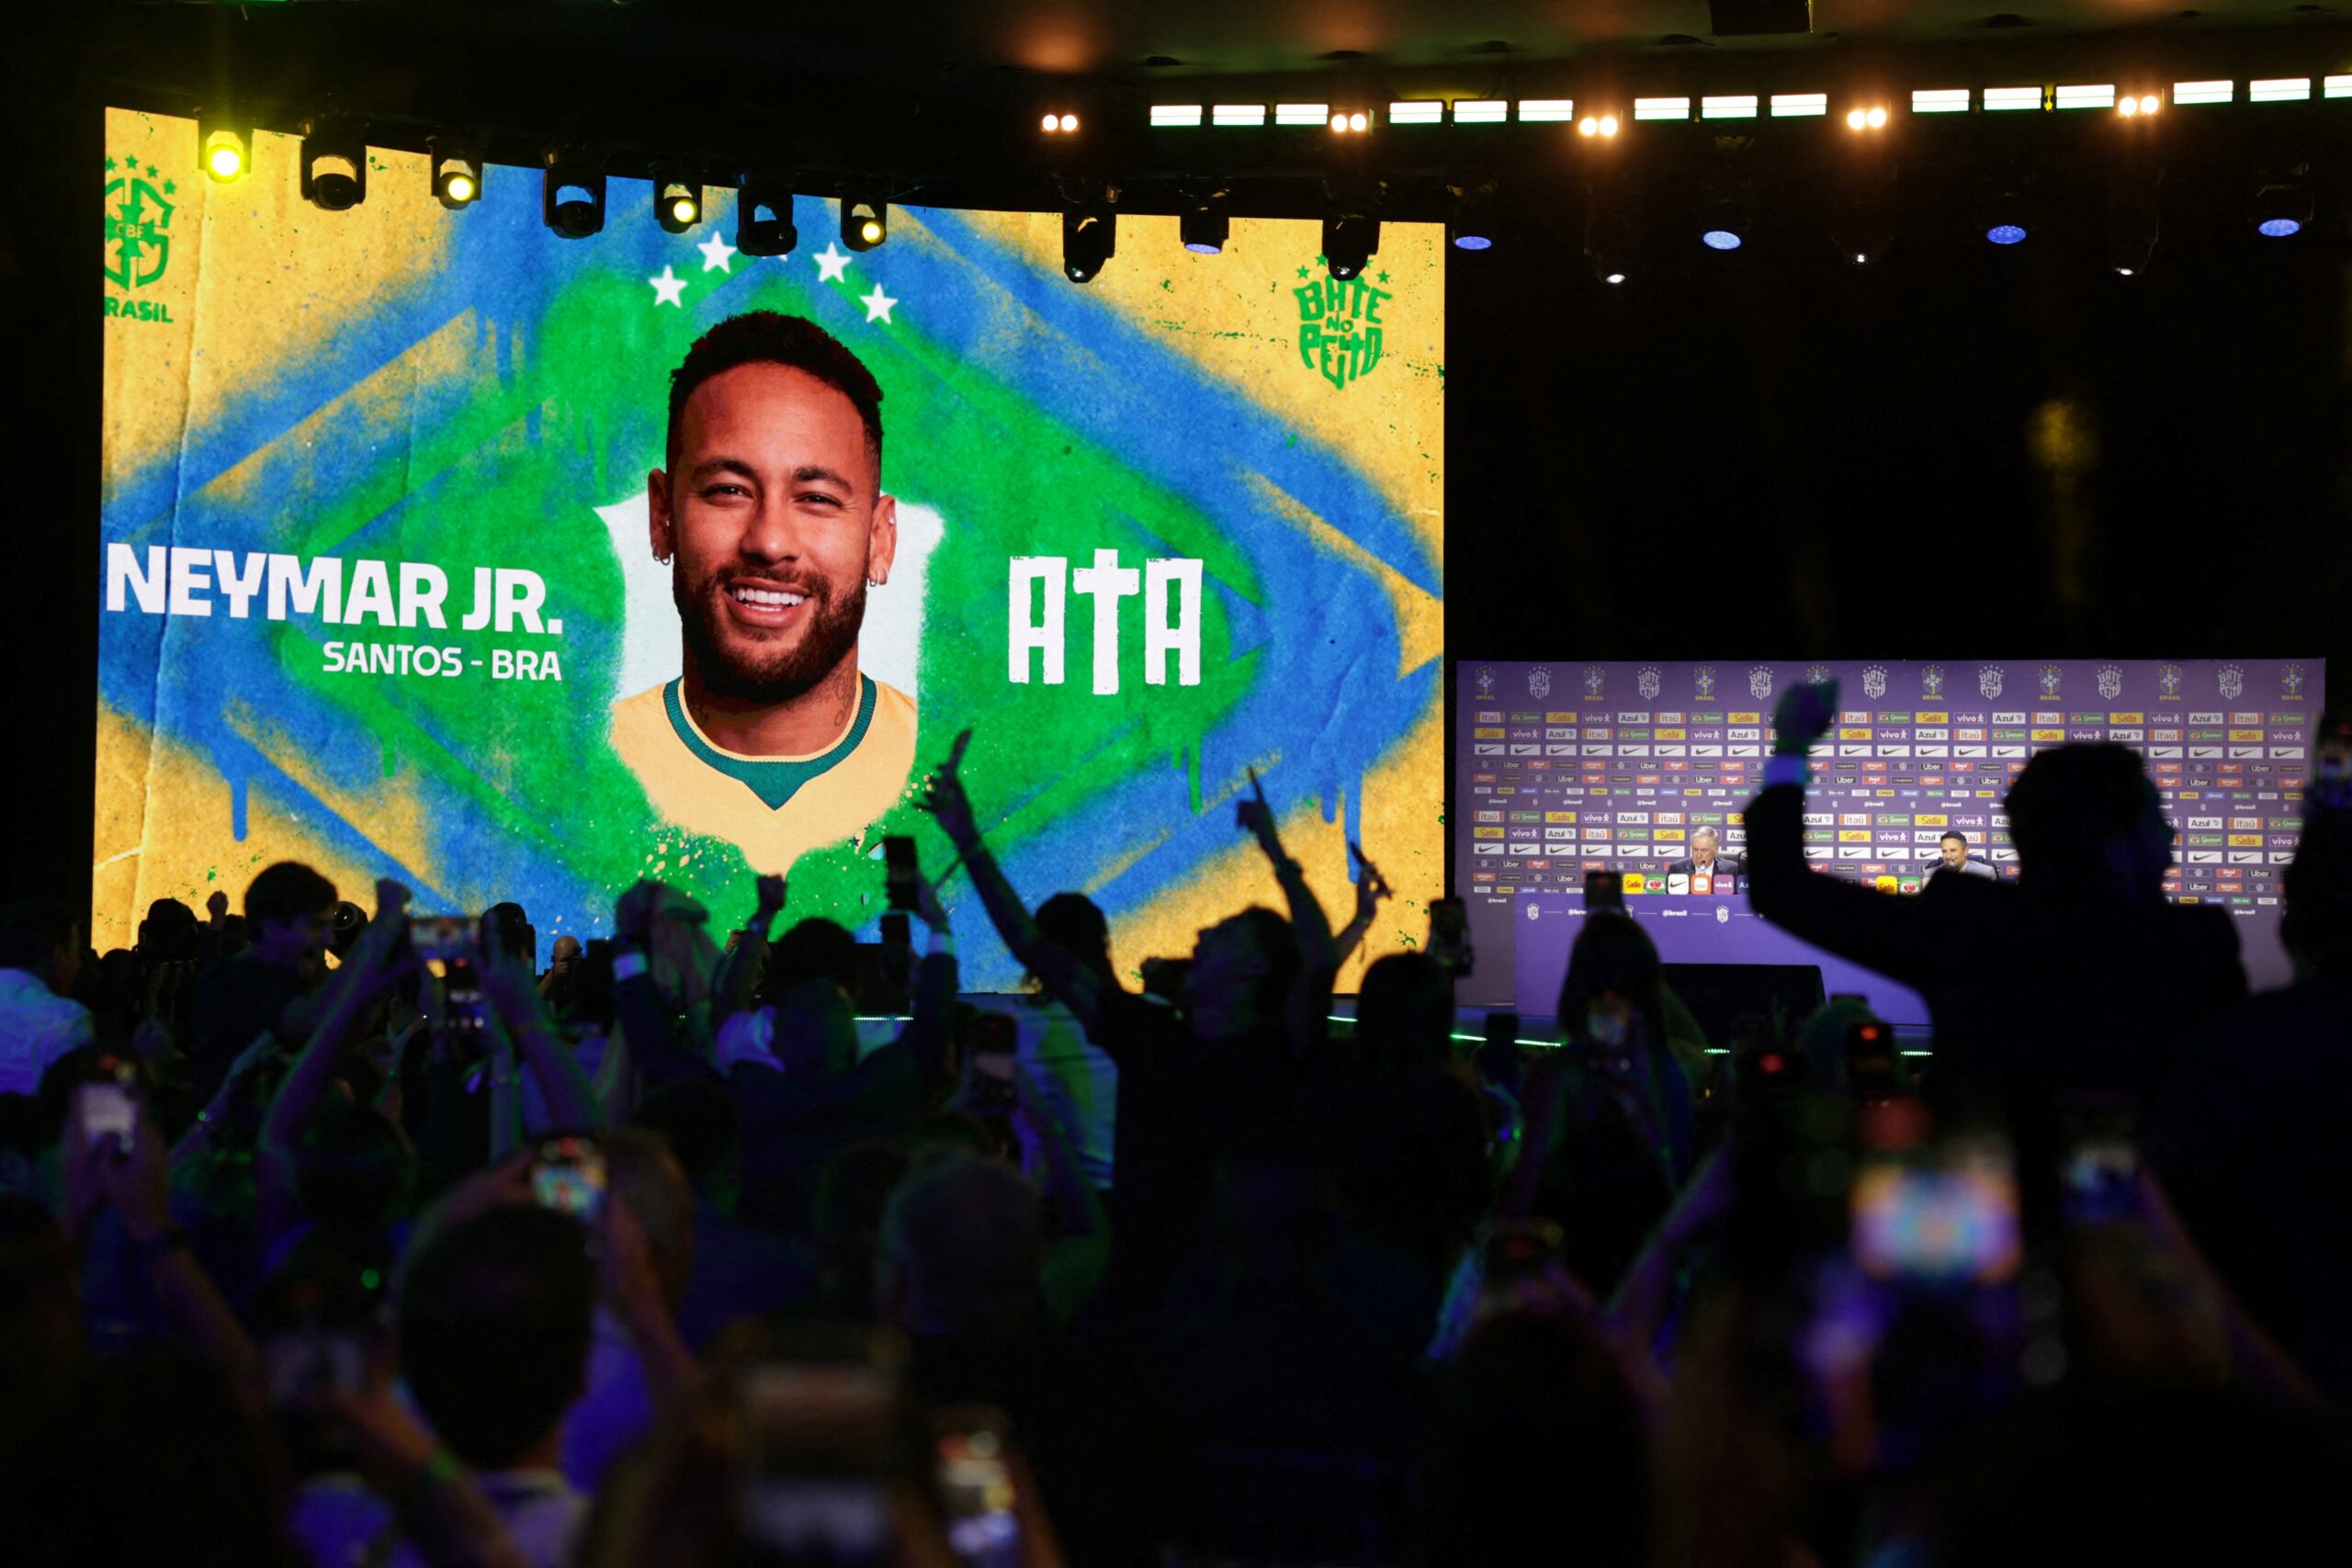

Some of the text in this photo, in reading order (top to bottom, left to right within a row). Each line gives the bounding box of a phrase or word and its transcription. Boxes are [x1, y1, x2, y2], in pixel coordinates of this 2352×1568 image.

[104, 297, 175, 323] RASIL
[1293, 275, 1393, 324] BATE
[1326, 313, 1354, 333] NO
[1299, 323, 1383, 390] PEITO
[107, 542, 562, 635] NEYMAR JR.
[1009, 548, 1203, 695] ATA
[323, 641, 462, 678] SANTOS
[492, 649, 562, 681] BRA
[2039, 731, 2057, 739] Sadia
[1922, 817, 1940, 825] Sadia
[1661, 830, 1678, 840] Sadia
[2236, 836, 2256, 845] Sadia
[1626, 880, 1641, 888] Sadia
